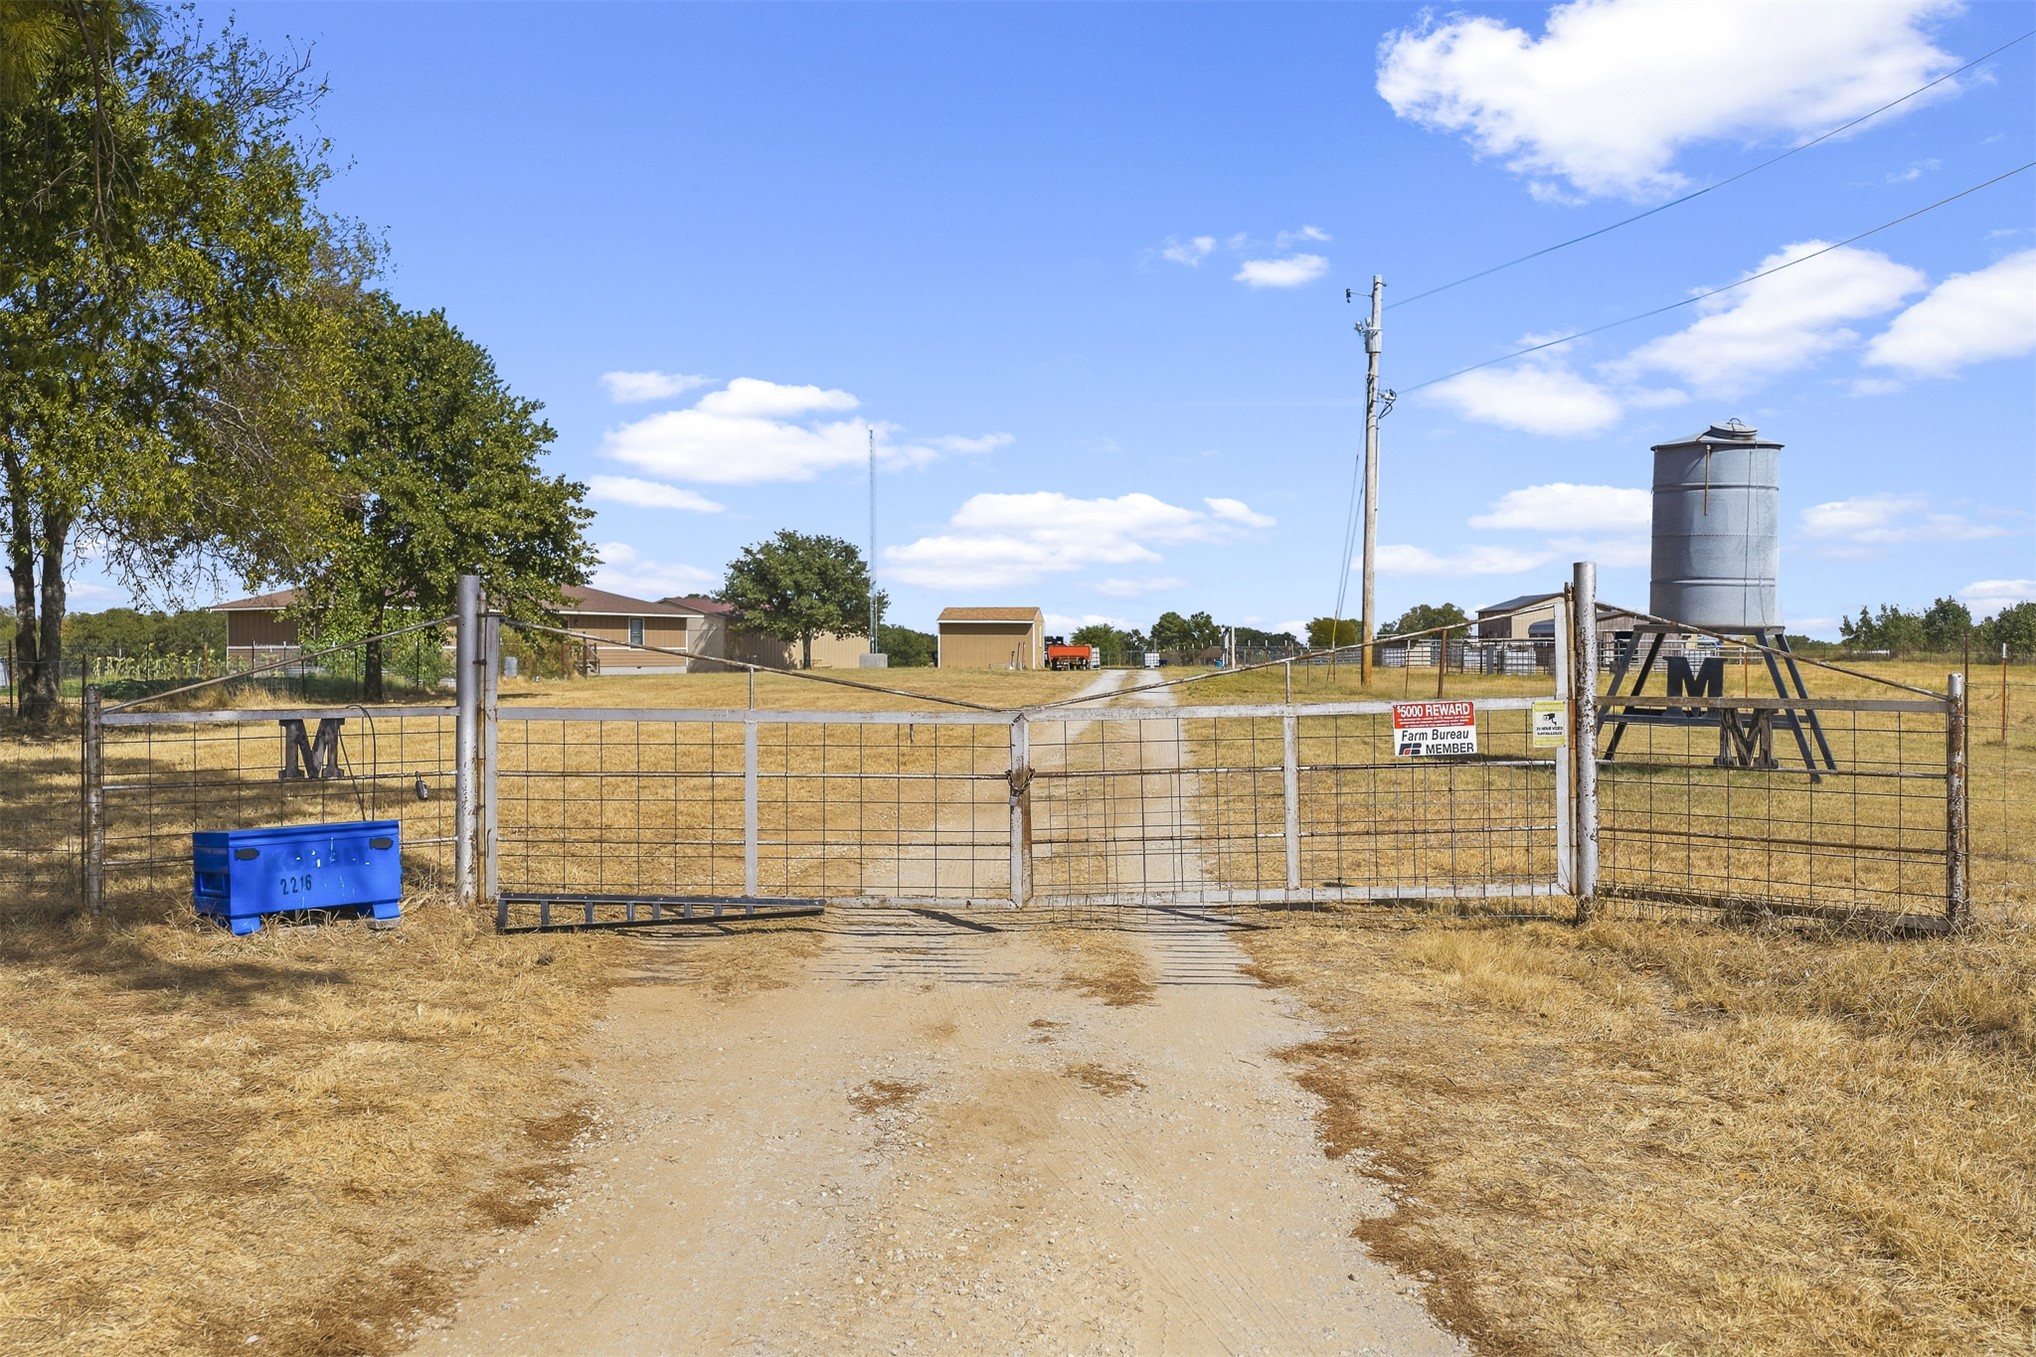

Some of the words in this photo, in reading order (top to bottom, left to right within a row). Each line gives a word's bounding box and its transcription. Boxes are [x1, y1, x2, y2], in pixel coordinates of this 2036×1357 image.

[1662, 656, 1728, 717] M
[1396, 705, 1423, 718] $5000
[1425, 703, 1470, 717] REWARD
[1401, 730, 1428, 742] Farm
[1432, 729, 1469, 741] Bureau
[1713, 708, 1779, 769] M
[278, 718, 345, 779] M
[1425, 743, 1475, 754] MEMBER
[280, 874, 312, 896] 2216
